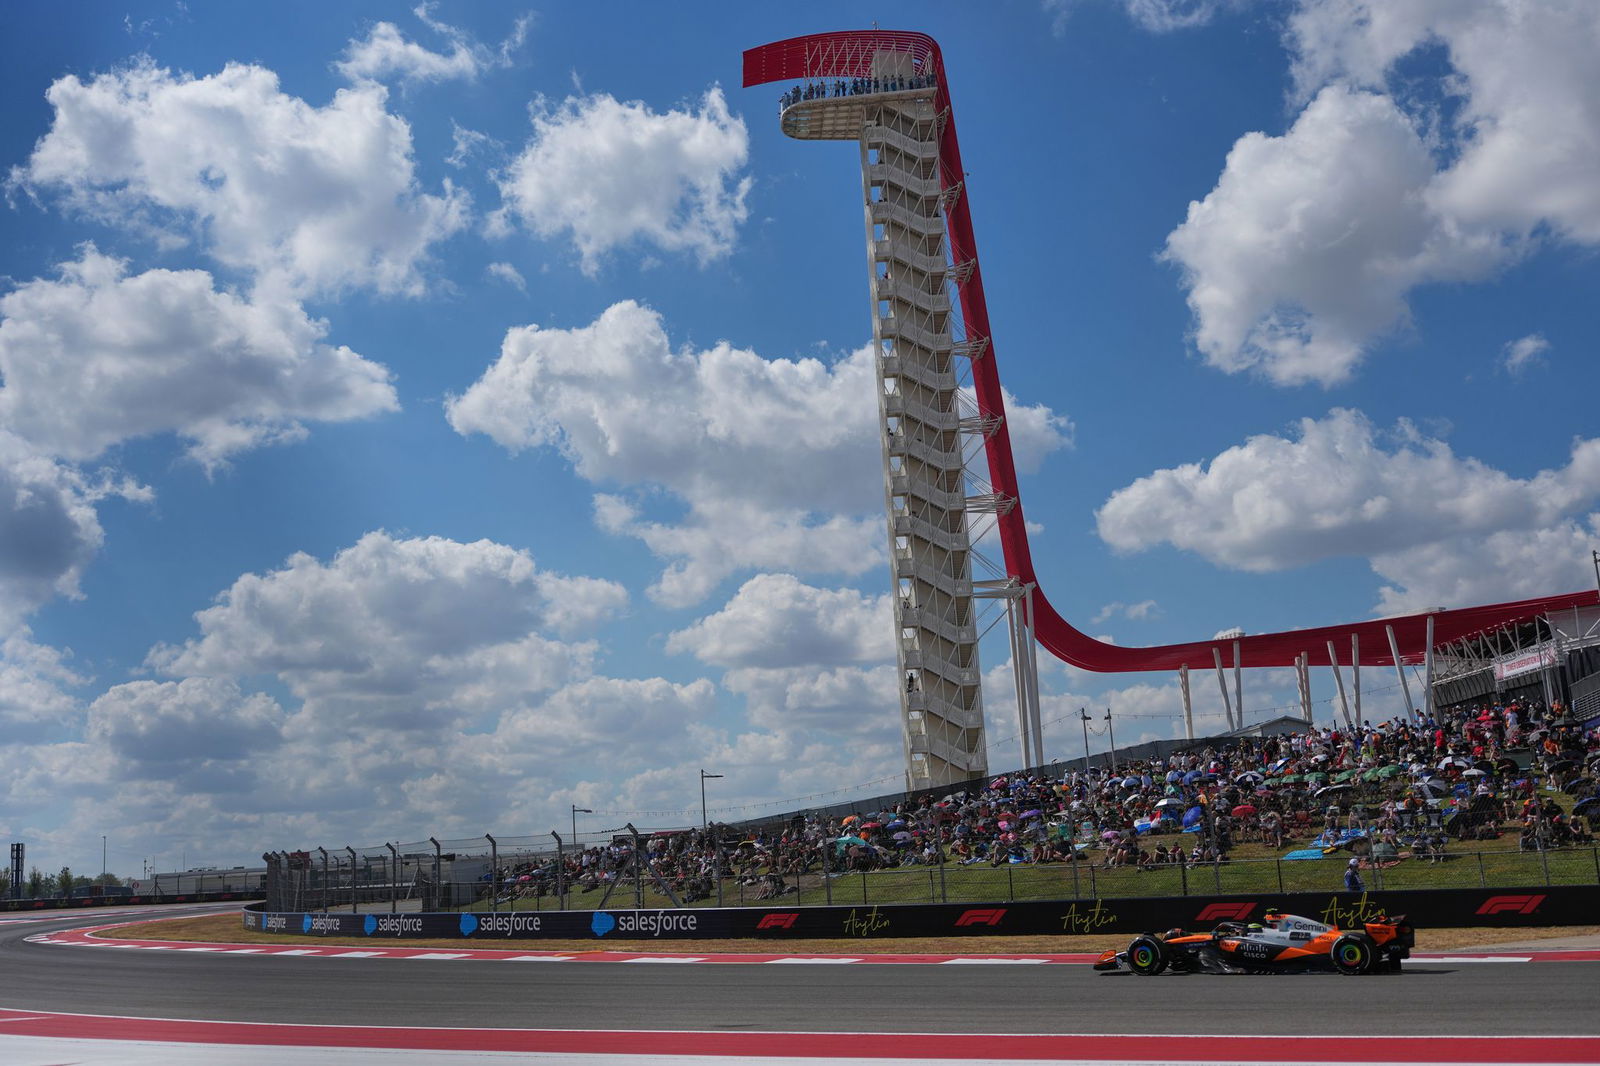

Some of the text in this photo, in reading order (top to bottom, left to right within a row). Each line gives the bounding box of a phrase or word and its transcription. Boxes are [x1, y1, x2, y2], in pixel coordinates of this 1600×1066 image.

[1060, 898, 1118, 933] Austin
[1320, 891, 1386, 929] Austin
[1474, 894, 1548, 914] F1
[311, 913, 340, 934] salesforce
[378, 912, 423, 936] salesforce
[480, 912, 541, 936] salesforce
[618, 910, 697, 936] salesforce
[843, 904, 890, 936] Austin
[1294, 921, 1328, 933] Gemini
